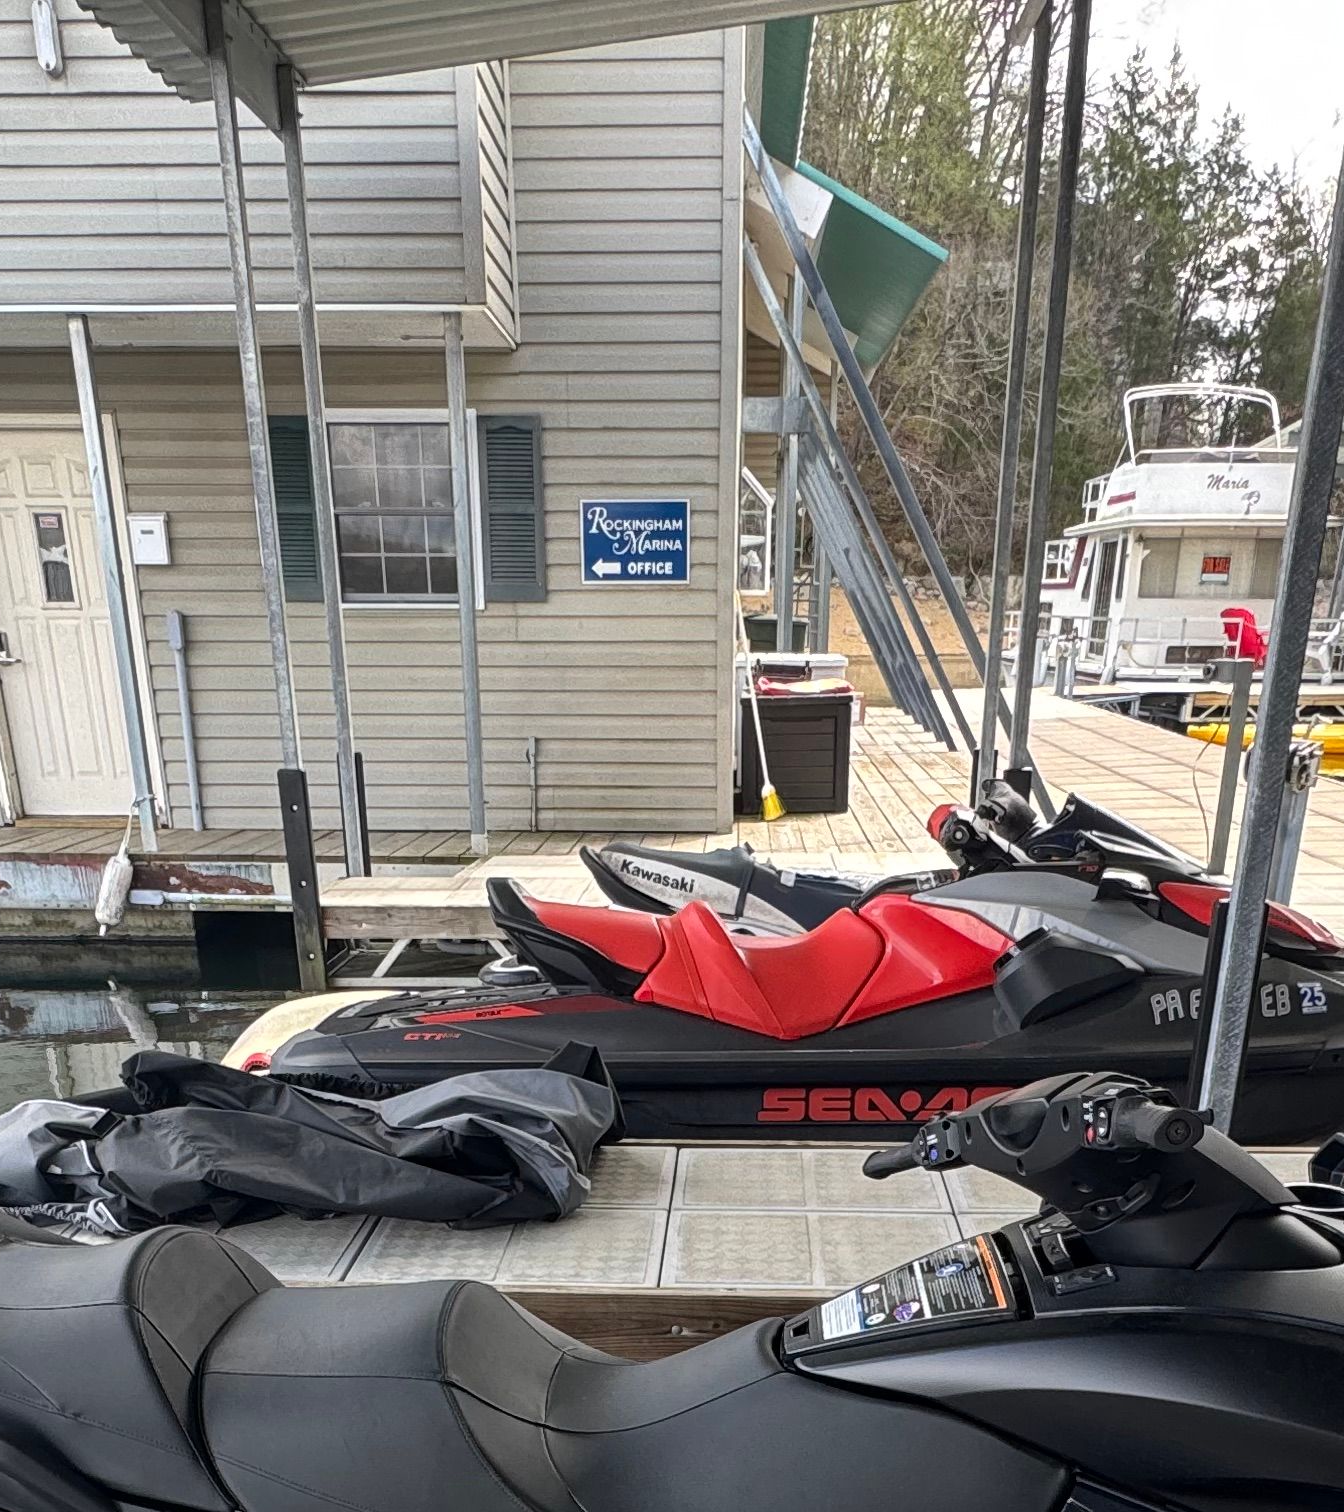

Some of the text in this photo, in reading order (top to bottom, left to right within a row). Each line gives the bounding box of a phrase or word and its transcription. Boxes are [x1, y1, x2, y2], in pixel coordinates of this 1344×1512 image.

[1207, 473, 1250, 490] Maria
[587, 506, 683, 540] ROCKINGHAM
[612, 531, 683, 555] MARINA
[627, 561, 674, 575] OFFICE
[1203, 557, 1230, 573] FOR SALE
[620, 858, 696, 894] Kawasaki
[1150, 989, 1185, 1025] PA
[1260, 983, 1291, 1017] EB
[1299, 986, 1327, 1008] 25
